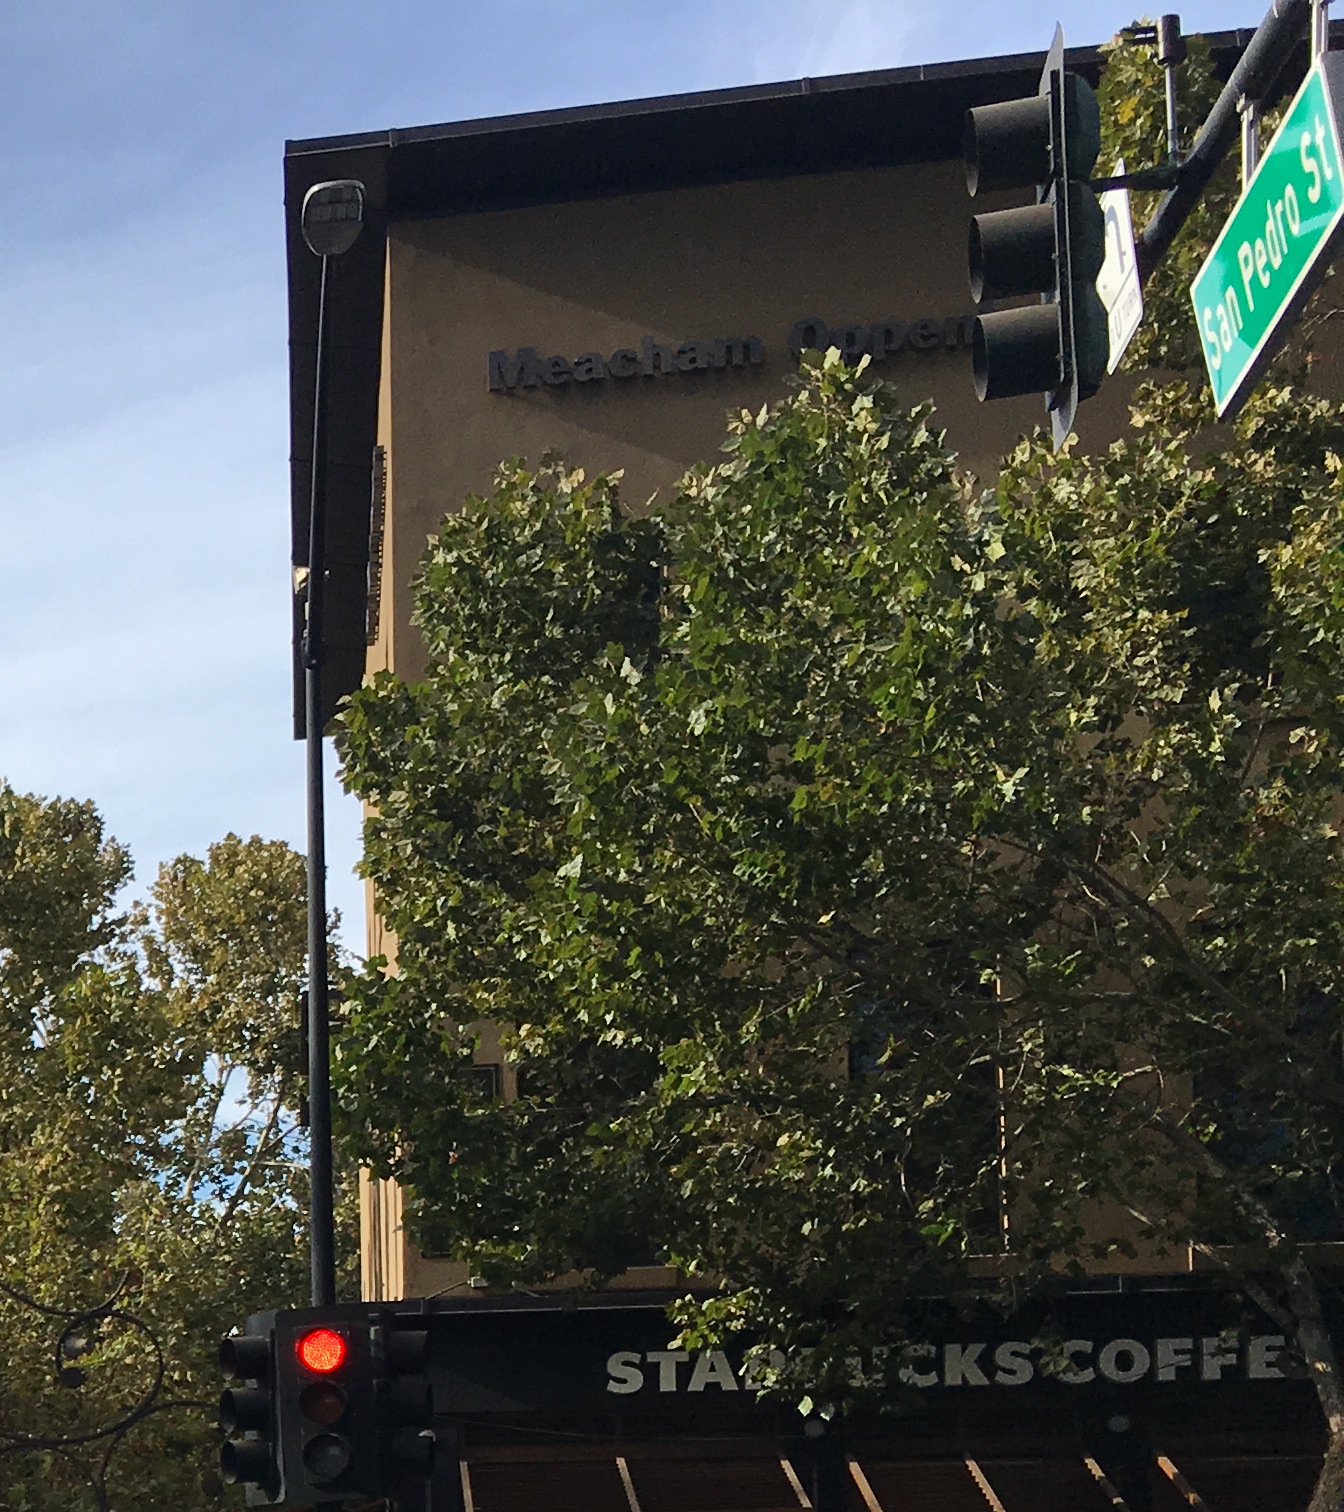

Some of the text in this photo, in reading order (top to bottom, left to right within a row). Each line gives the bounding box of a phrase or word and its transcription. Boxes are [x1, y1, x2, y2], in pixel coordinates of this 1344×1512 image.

[1203, 113, 1333, 371] San Pedro St
[488, 334, 764, 392] Meacham
